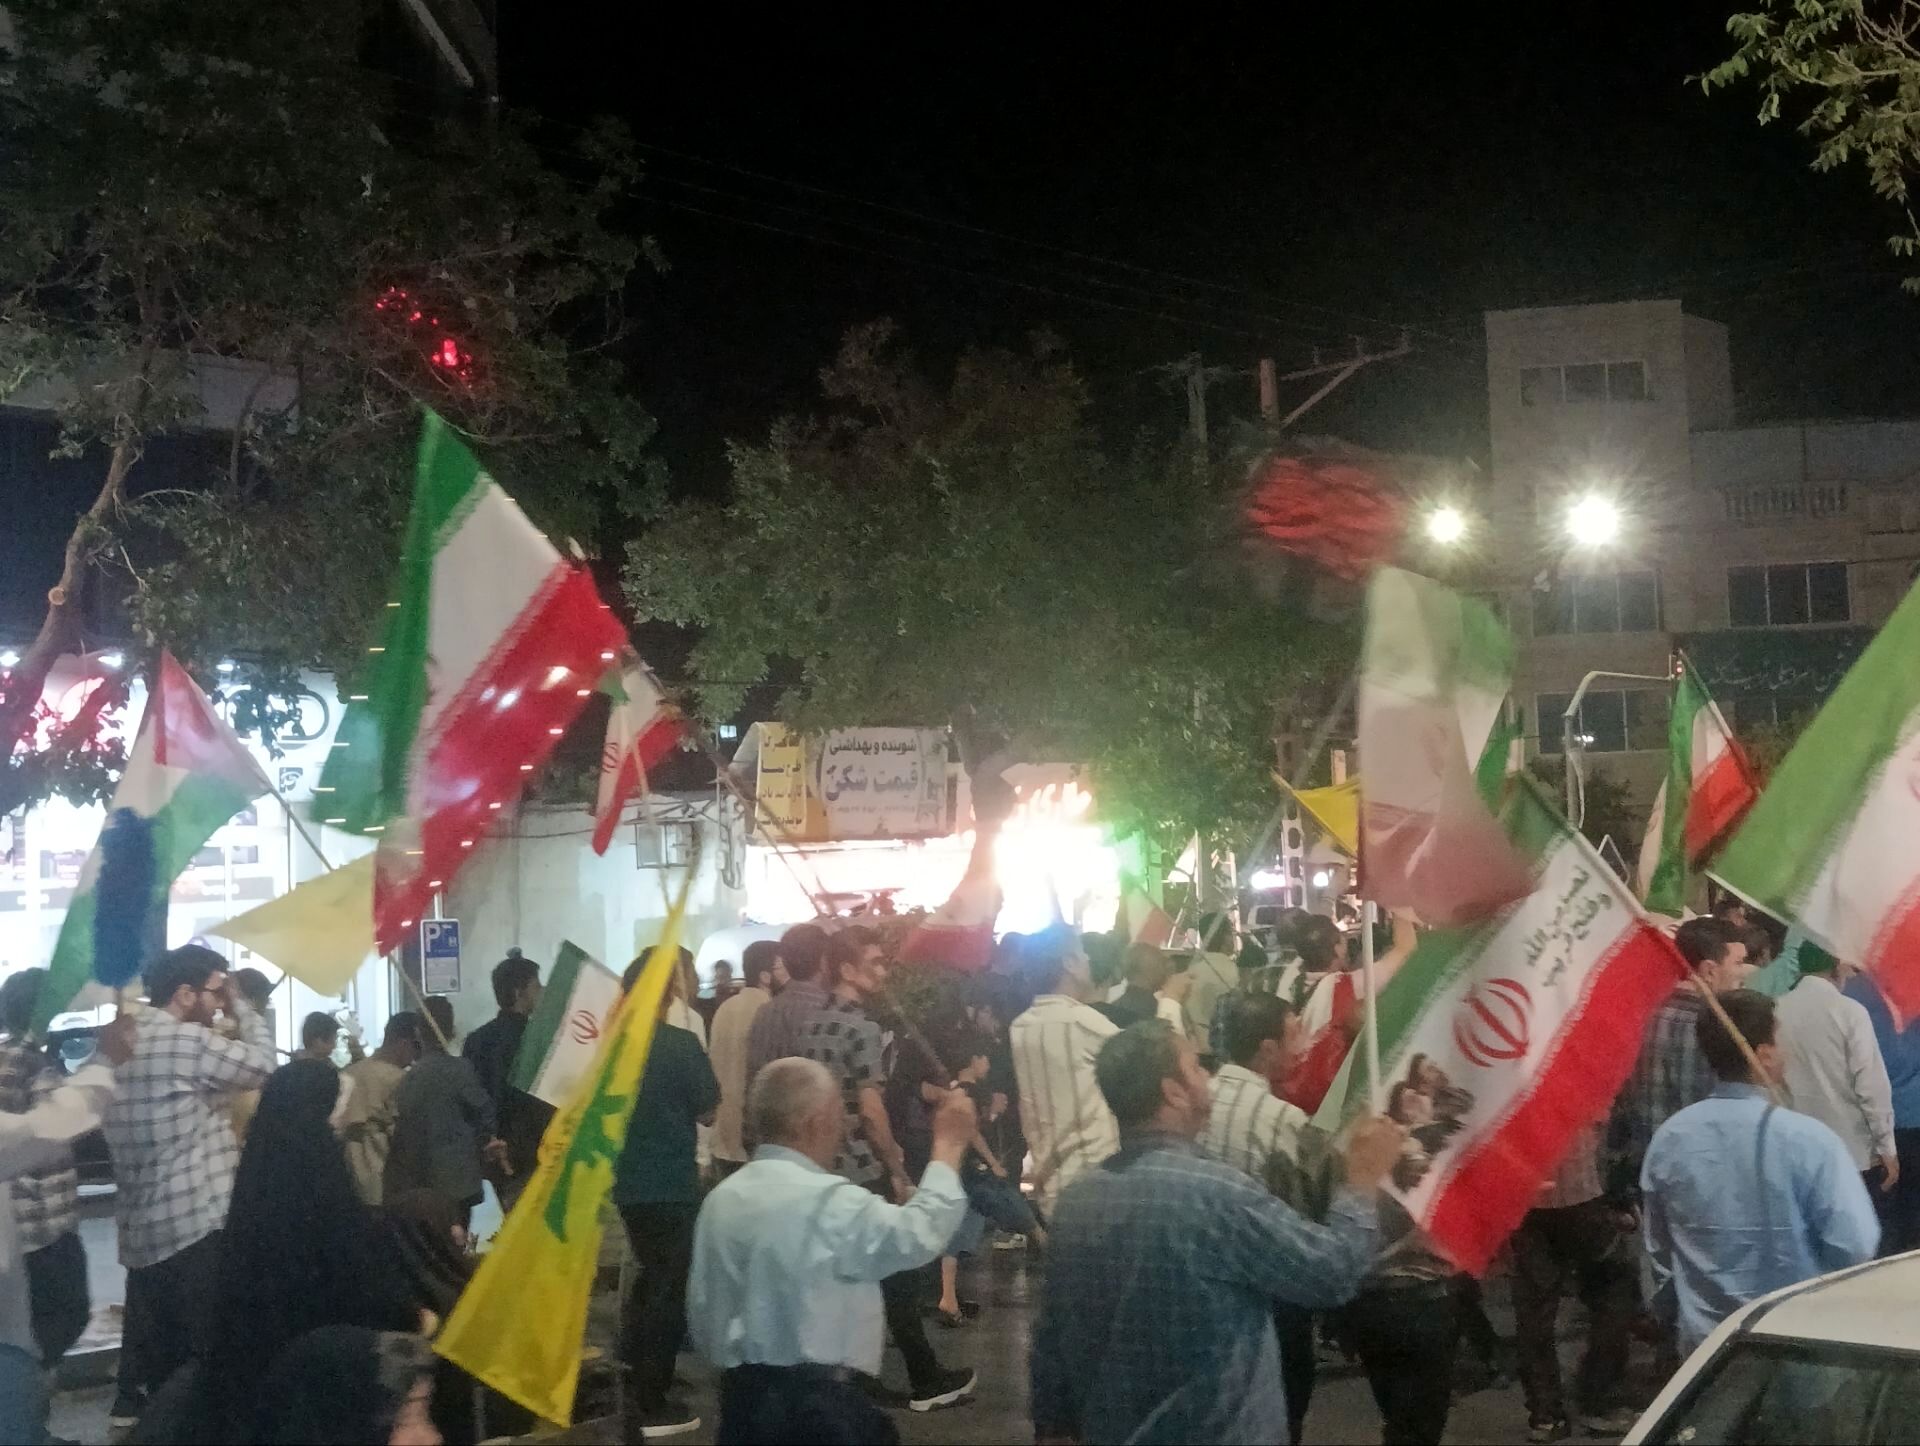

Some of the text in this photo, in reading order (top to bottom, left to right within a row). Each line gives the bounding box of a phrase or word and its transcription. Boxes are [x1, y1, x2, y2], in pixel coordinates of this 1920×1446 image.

[873, 741, 880, 755] و
[873, 761, 919, 798] قیمت
[425, 923, 441, 952] P
